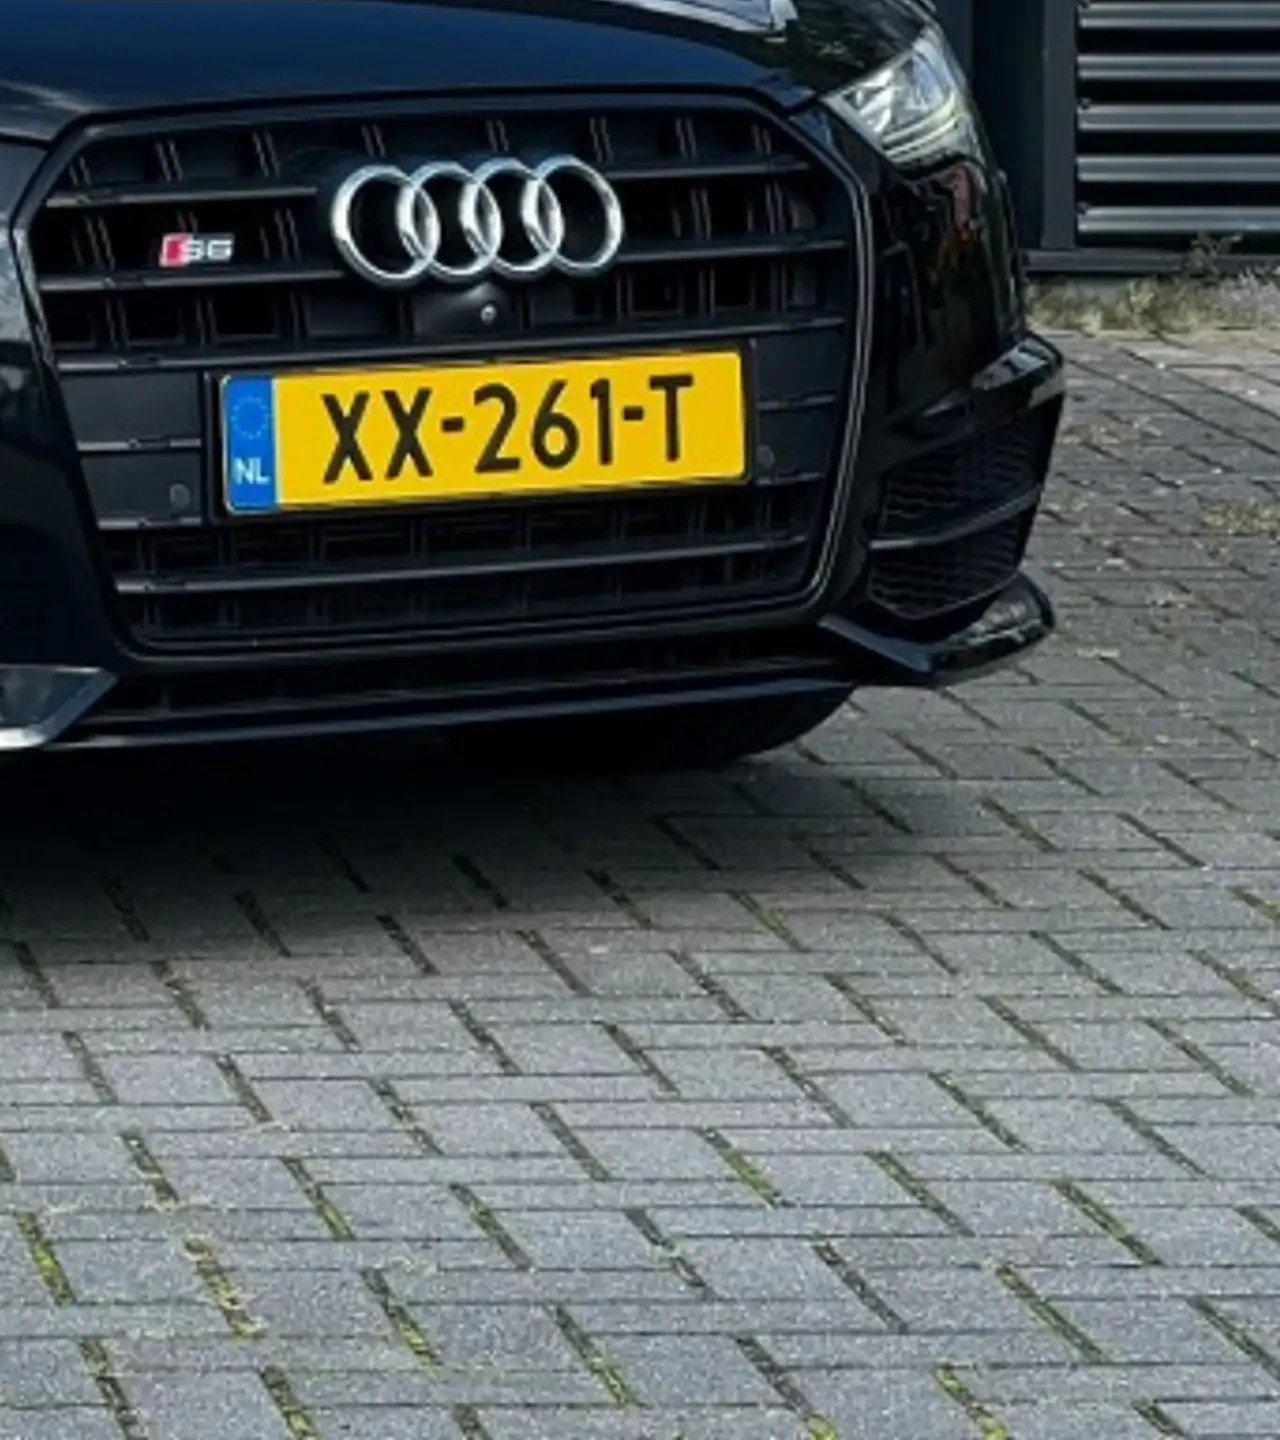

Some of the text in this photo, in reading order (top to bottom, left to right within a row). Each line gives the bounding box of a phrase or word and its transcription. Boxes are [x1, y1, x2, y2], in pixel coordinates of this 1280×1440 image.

[175, 236, 234, 264] S6
[320, 371, 695, 486] XX-261-T
[236, 458, 269, 486] NL
